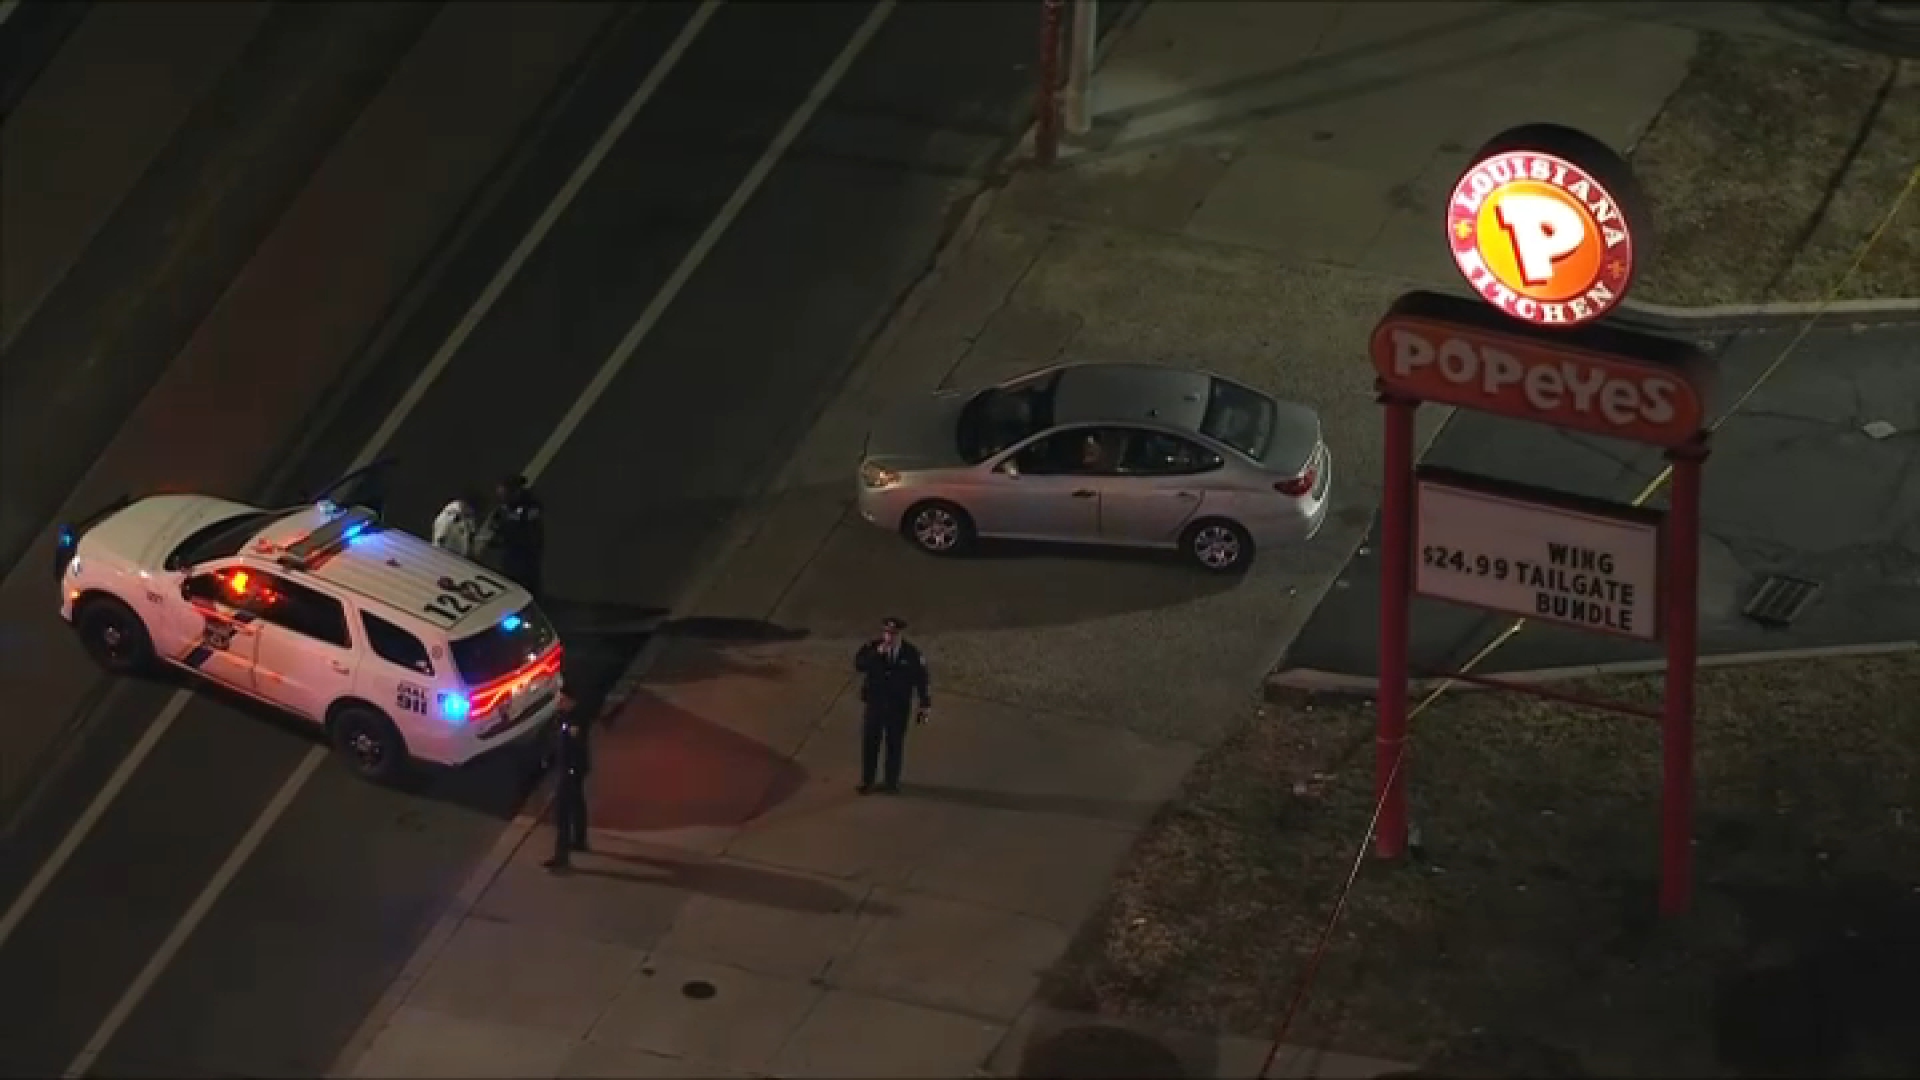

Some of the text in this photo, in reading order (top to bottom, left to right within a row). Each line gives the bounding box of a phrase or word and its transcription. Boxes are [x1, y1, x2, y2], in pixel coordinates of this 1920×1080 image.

[1454, 156, 1626, 248] LOUISIANA
[1496, 194, 1585, 285] P
[1454, 248, 1614, 323] KITCHEN
[1423, 545, 1634, 606] $24.99 TAILGATE
[1547, 541, 1615, 575] WING
[1535, 591, 1633, 631] BUNDLE
[396, 694, 428, 715] 911
